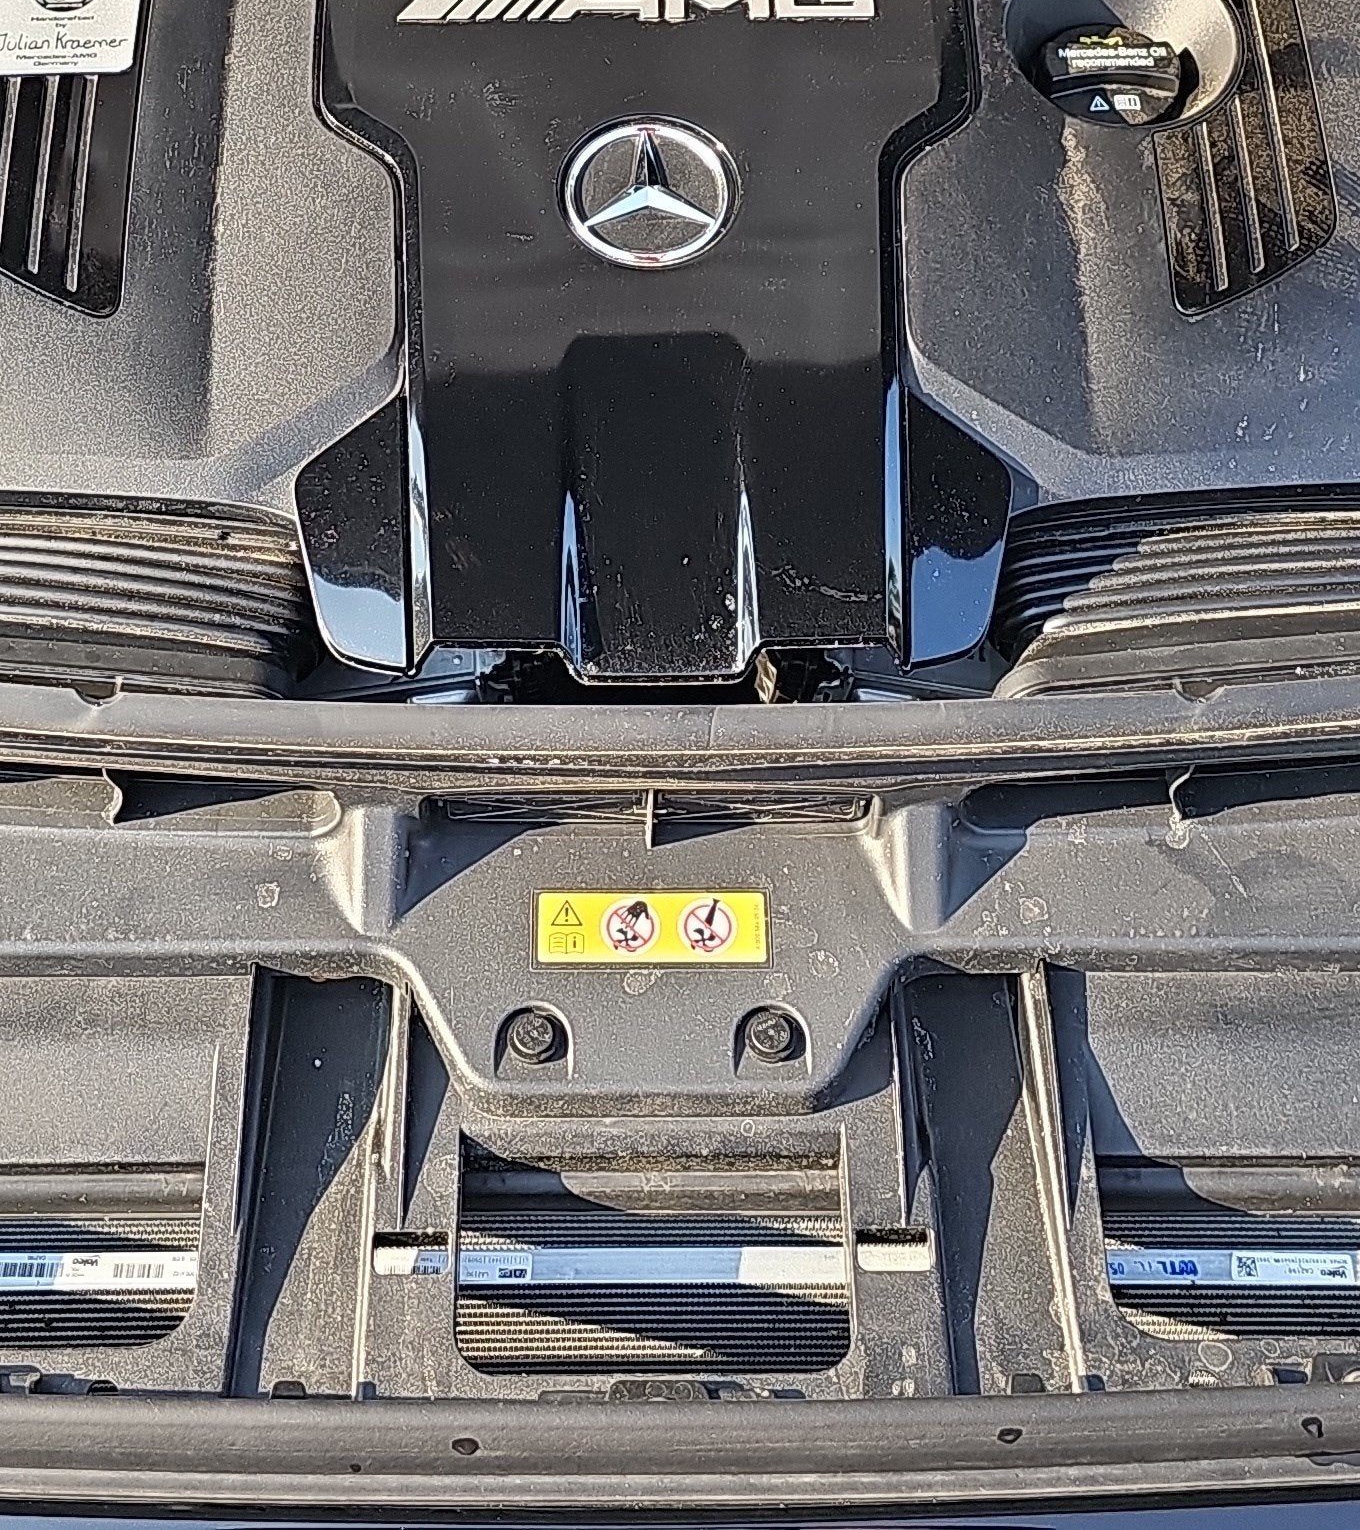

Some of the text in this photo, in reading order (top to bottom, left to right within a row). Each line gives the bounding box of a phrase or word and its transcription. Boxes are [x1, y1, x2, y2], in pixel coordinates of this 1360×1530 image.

[55, 30, 129, 50] Kraemer
[15, 52, 97, 61] Mercedes-AMG
[1058, 46, 1168, 58] Mercedes-Benz Oil
[1071, 57, 1155, 68] recommended
[72, 1257, 100, 1267] Valeo
[1321, 1266, 1348, 1277] Valeo
